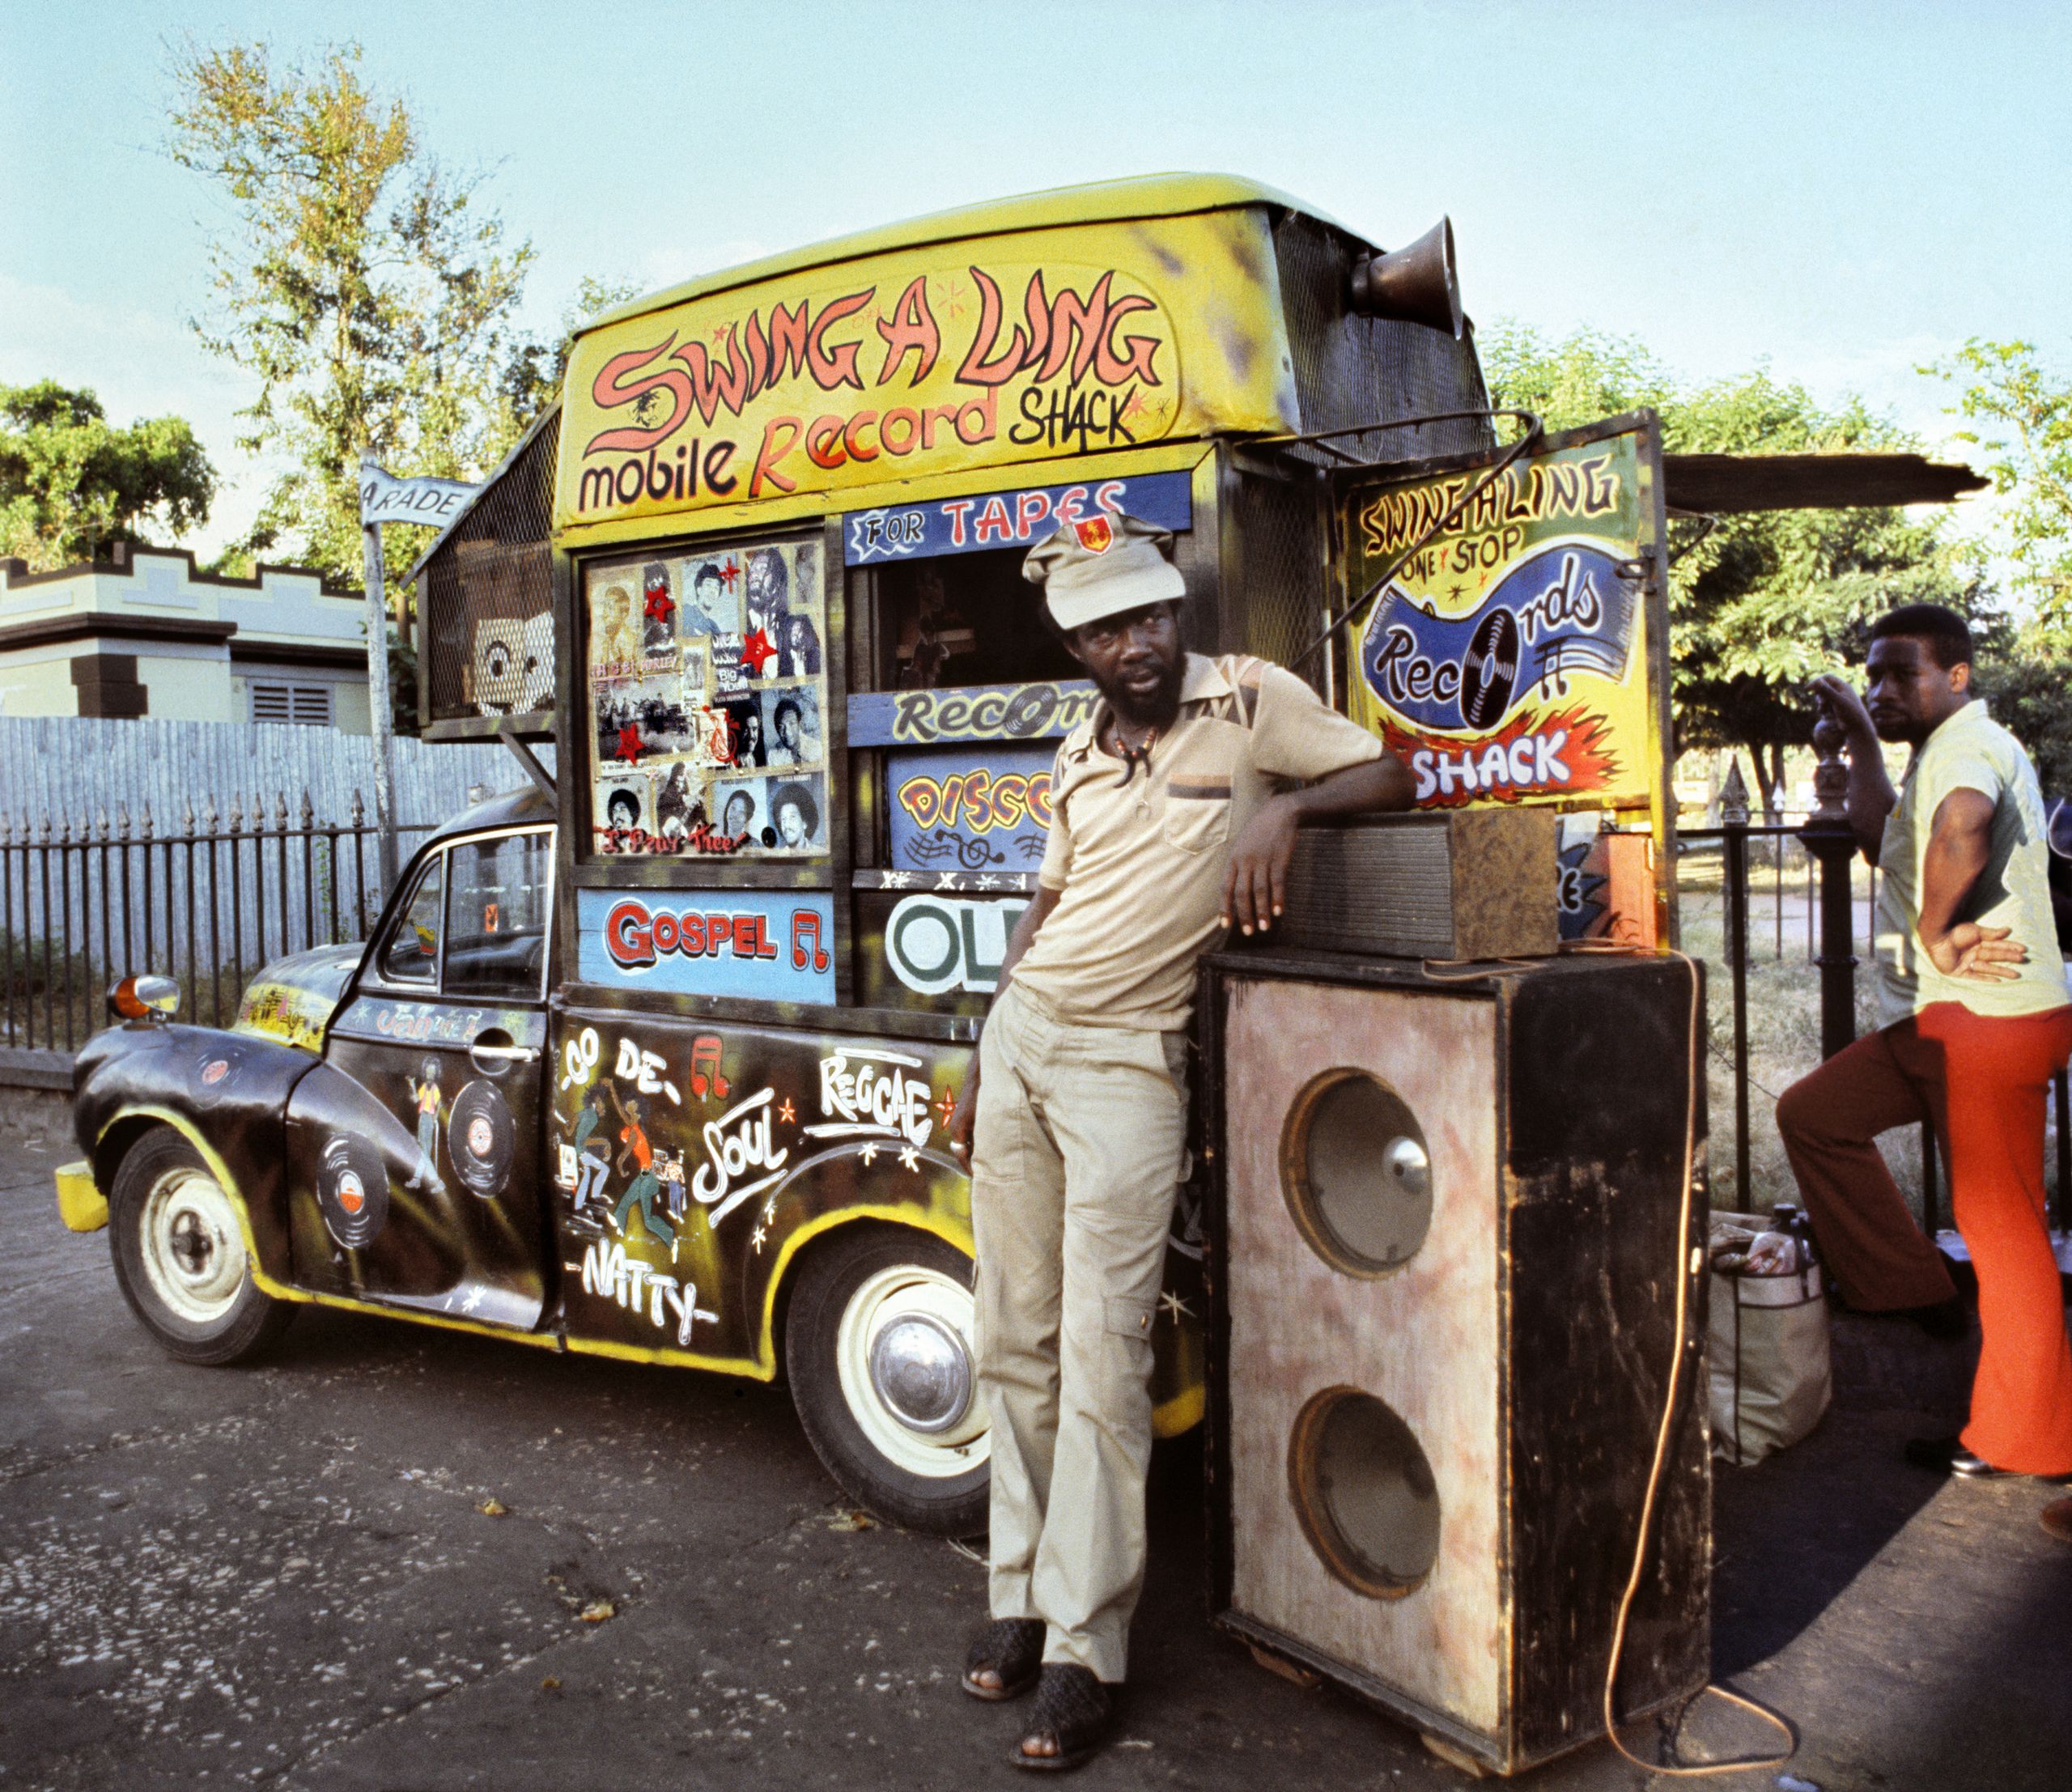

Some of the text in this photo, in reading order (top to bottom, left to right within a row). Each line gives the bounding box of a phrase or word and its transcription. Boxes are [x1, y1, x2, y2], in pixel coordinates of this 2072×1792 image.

[583, 265, 1162, 461] SWING A LING
[578, 384, 1139, 513] mobile Record SHACK
[866, 481, 1127, 547] FOR TAPES
[1360, 477, 1468, 557] SWING
[1399, 525, 1524, 585] ONE STOP
[1412, 729, 1570, 800] SHACK
[605, 898, 779, 970] GOSPEL
[888, 898, 1030, 989] OL
[819, 1055, 933, 1147] REGGAE
[692, 1104, 788, 1204] SOUL
[582, 1236, 699, 1346] NATTY
